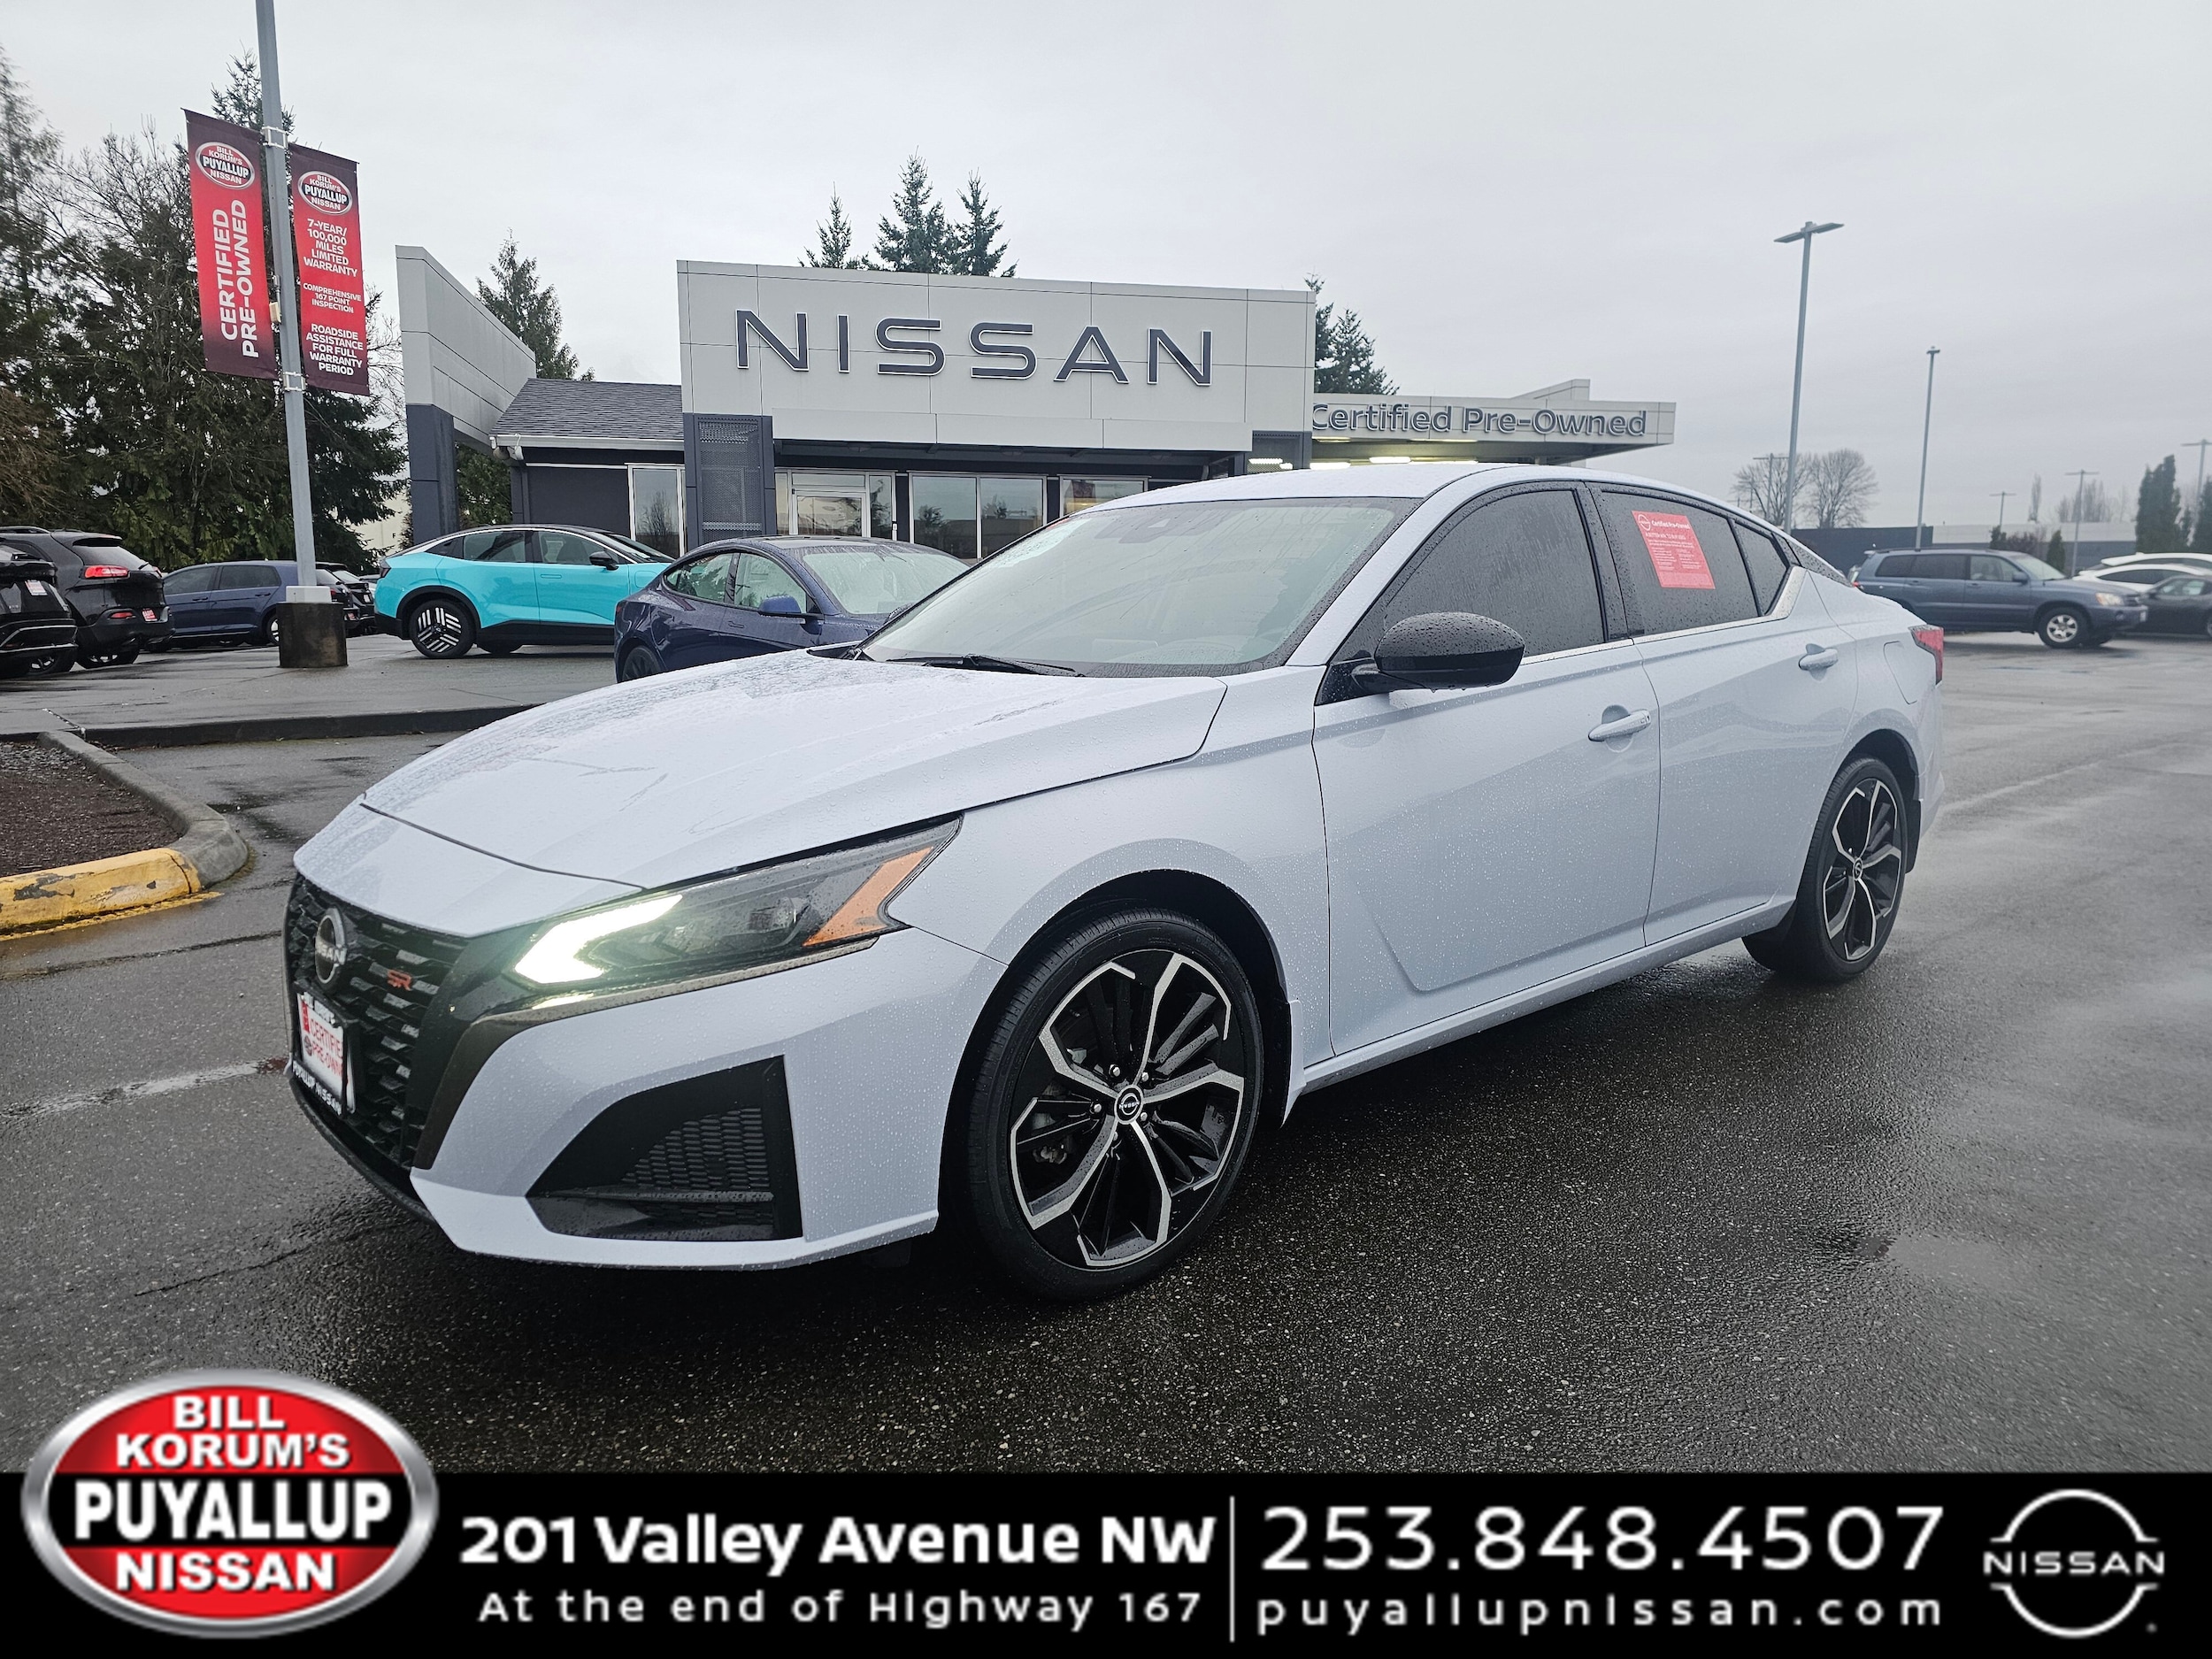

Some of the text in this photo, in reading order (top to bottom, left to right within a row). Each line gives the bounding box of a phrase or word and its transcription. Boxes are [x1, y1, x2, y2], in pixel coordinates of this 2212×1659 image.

[208, 150, 243, 165] KORUM'S
[217, 146, 234, 157] BILL
[202, 155, 250, 179] PUYALLUP
[210, 168, 242, 185] NISSAN
[309, 178, 342, 193] KORUM'S
[317, 174, 333, 185] BILL
[304, 183, 348, 204] PUYALLUP
[311, 196, 342, 211] NISSAN
[307, 218, 347, 236] 7-YEAR/
[307, 228, 347, 246] 100,000
[315, 240, 344, 255] MILES
[311, 249, 349, 266] LIMITED
[212, 209, 238, 341] CERTIFIED
[303, 257, 357, 277] WARRANTY
[231, 199, 259, 358] PRE-OWNED
[303, 283, 362, 302] COMPREHENSIVE
[314, 292, 350, 305] 167 POINT
[311, 298, 354, 313] INSPECTION
[305, 332, 364, 350] ASSISTANCE
[311, 323, 359, 341] ROADSIDE
[312, 342, 357, 358] FOR FULL
[735, 309, 1213, 387] NISSAN
[309, 350, 363, 368] WARRANTY
[318, 361, 355, 376] PERIOD
[1312, 403, 1647, 436] Certified Pre-Owned
